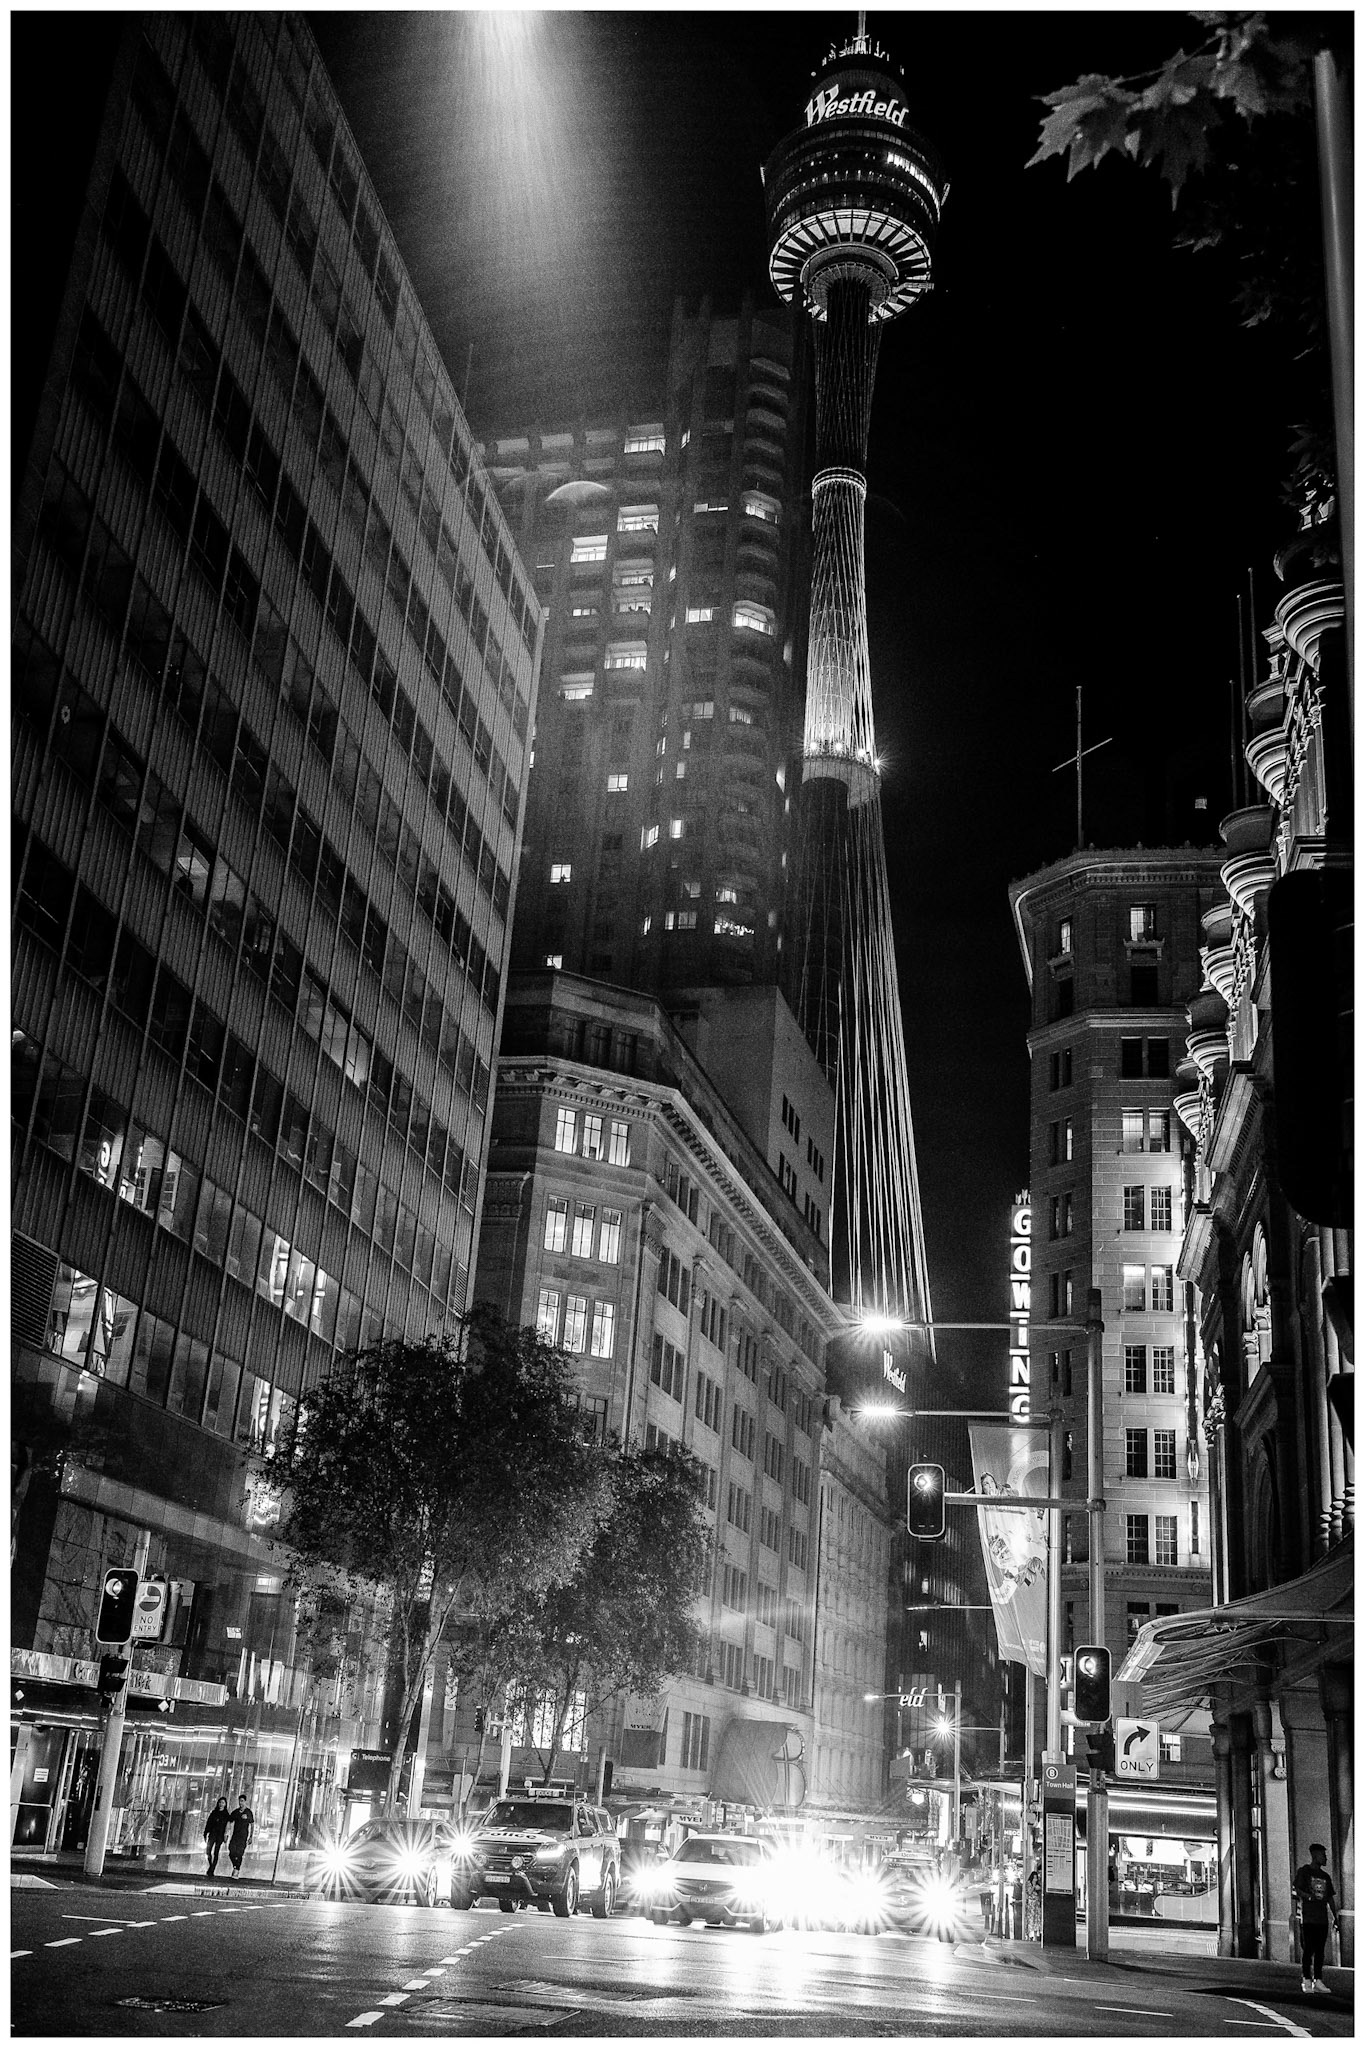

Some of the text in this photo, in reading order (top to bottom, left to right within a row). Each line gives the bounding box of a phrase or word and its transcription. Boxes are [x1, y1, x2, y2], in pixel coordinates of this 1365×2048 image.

[804, 84, 909, 128] Westfield
[883, 1350, 907, 1393] Westfield
[140, 1616, 154, 1624] NO
[362, 1753, 391, 1762] Telephone
[1120, 1761, 1154, 1772] ONLY
[478, 1831, 537, 1840] Police
